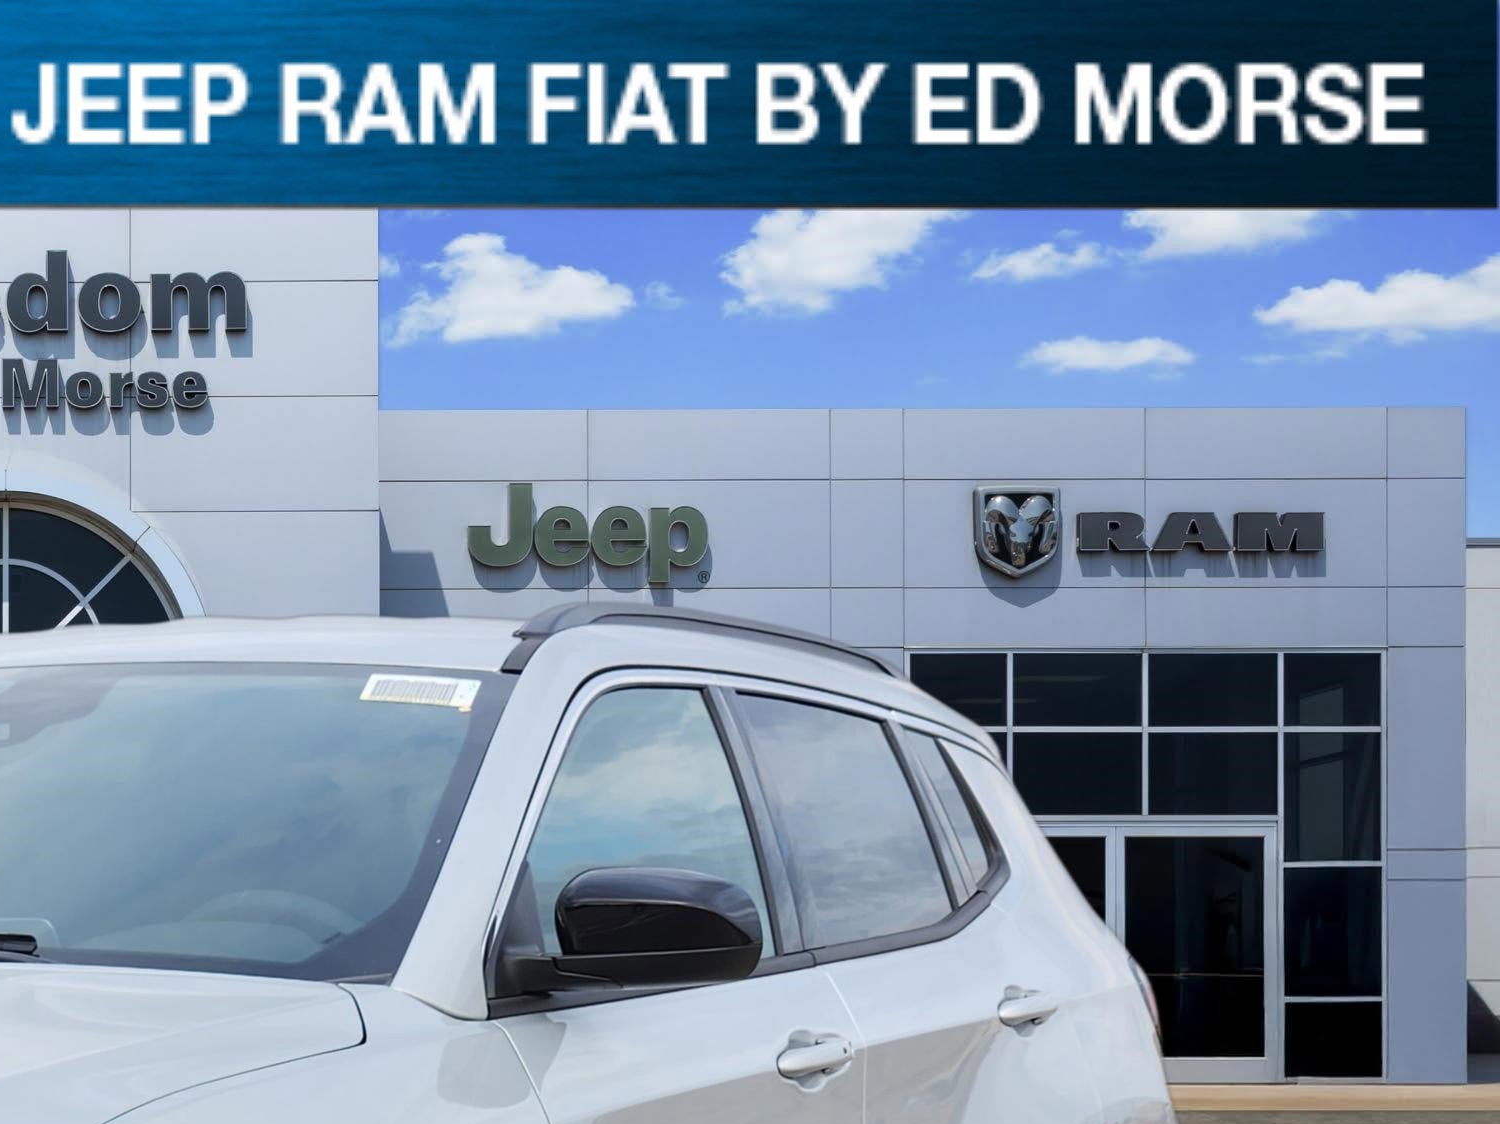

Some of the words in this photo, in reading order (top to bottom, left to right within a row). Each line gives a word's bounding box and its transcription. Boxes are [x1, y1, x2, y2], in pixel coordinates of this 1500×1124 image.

[2, 358, 210, 409] Morse
[467, 482, 709, 584] Jeep
[1075, 511, 1326, 552] RAM
